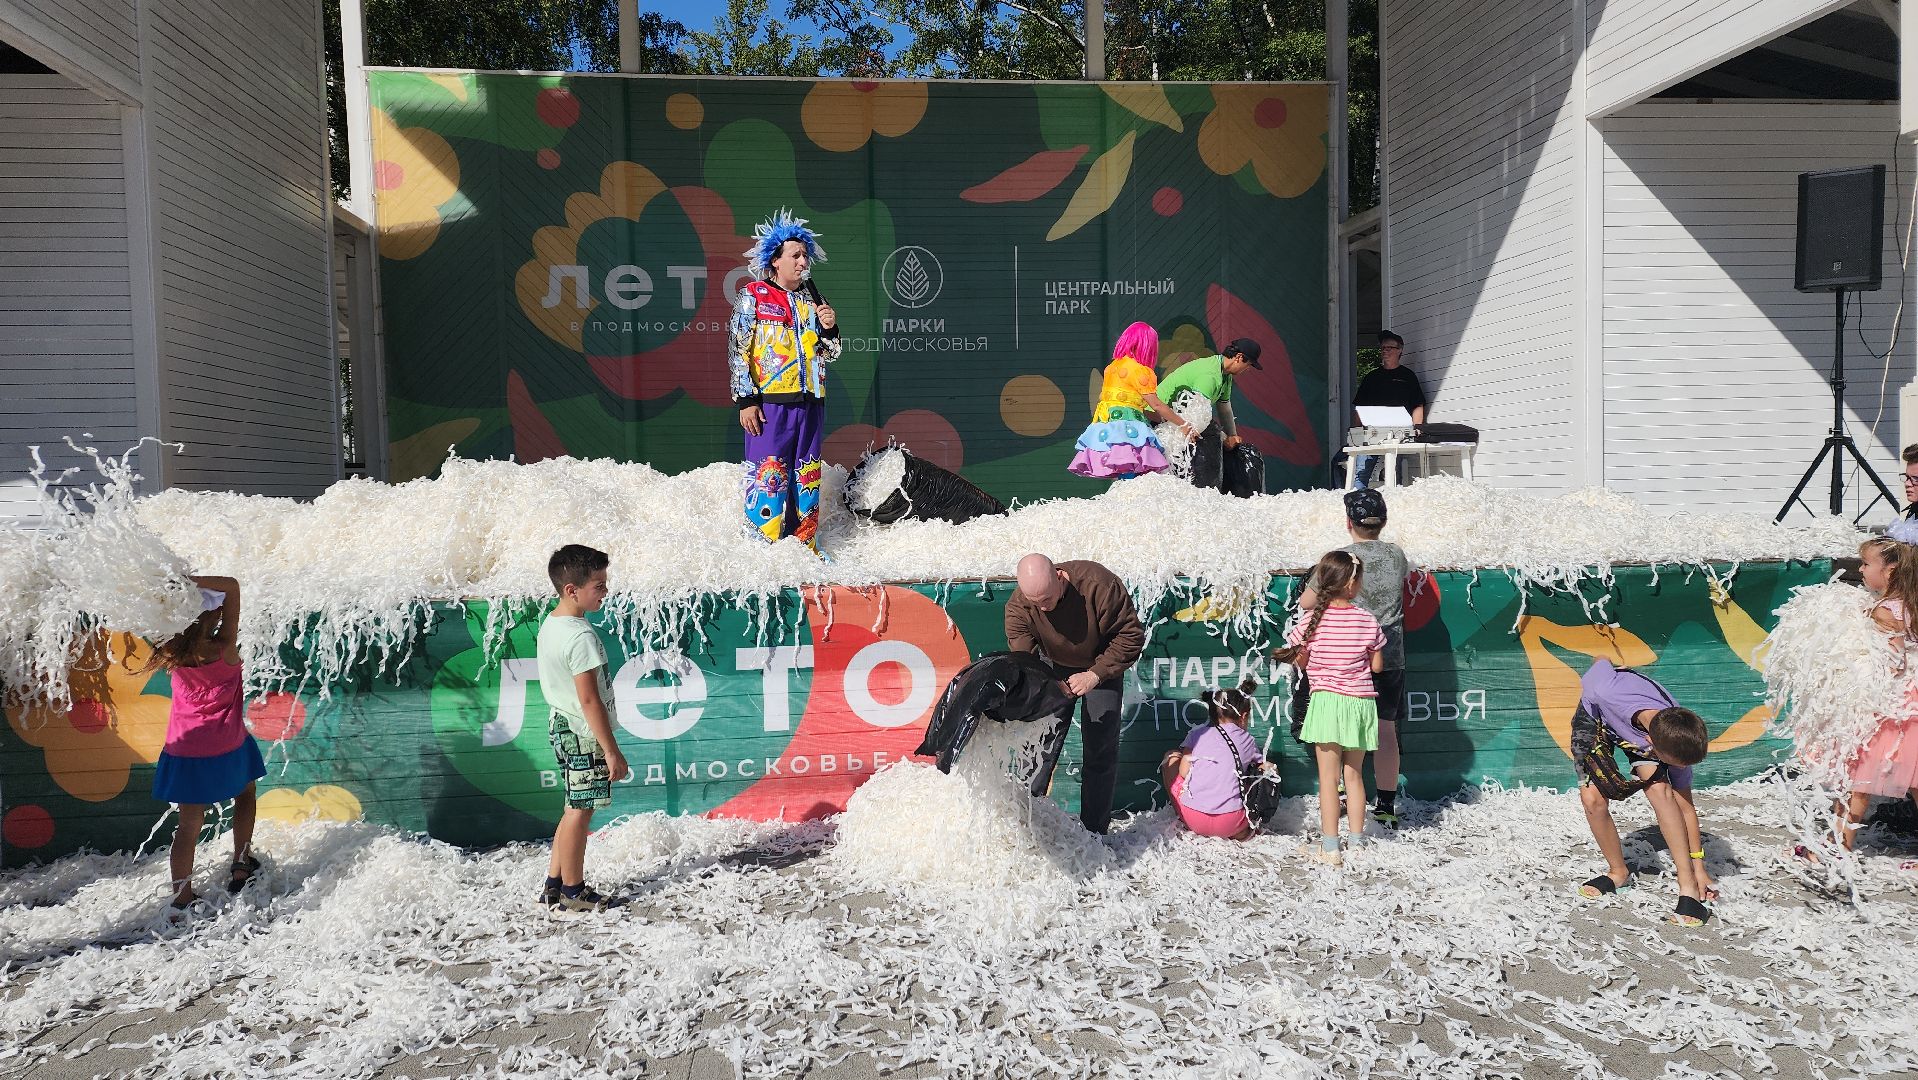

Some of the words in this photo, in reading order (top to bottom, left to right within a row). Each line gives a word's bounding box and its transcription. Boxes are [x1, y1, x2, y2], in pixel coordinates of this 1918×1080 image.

[1045, 277, 1175, 298] ЦЕНТРАЛЬНЫЙ
[1045, 300, 1091, 314] ПАРК
[570, 321, 580, 331] В
[882, 318, 945, 333] ПАРКИ
[840, 336, 988, 352] ПОДМОСКОВЬЯ
[540, 770, 558, 788] В
